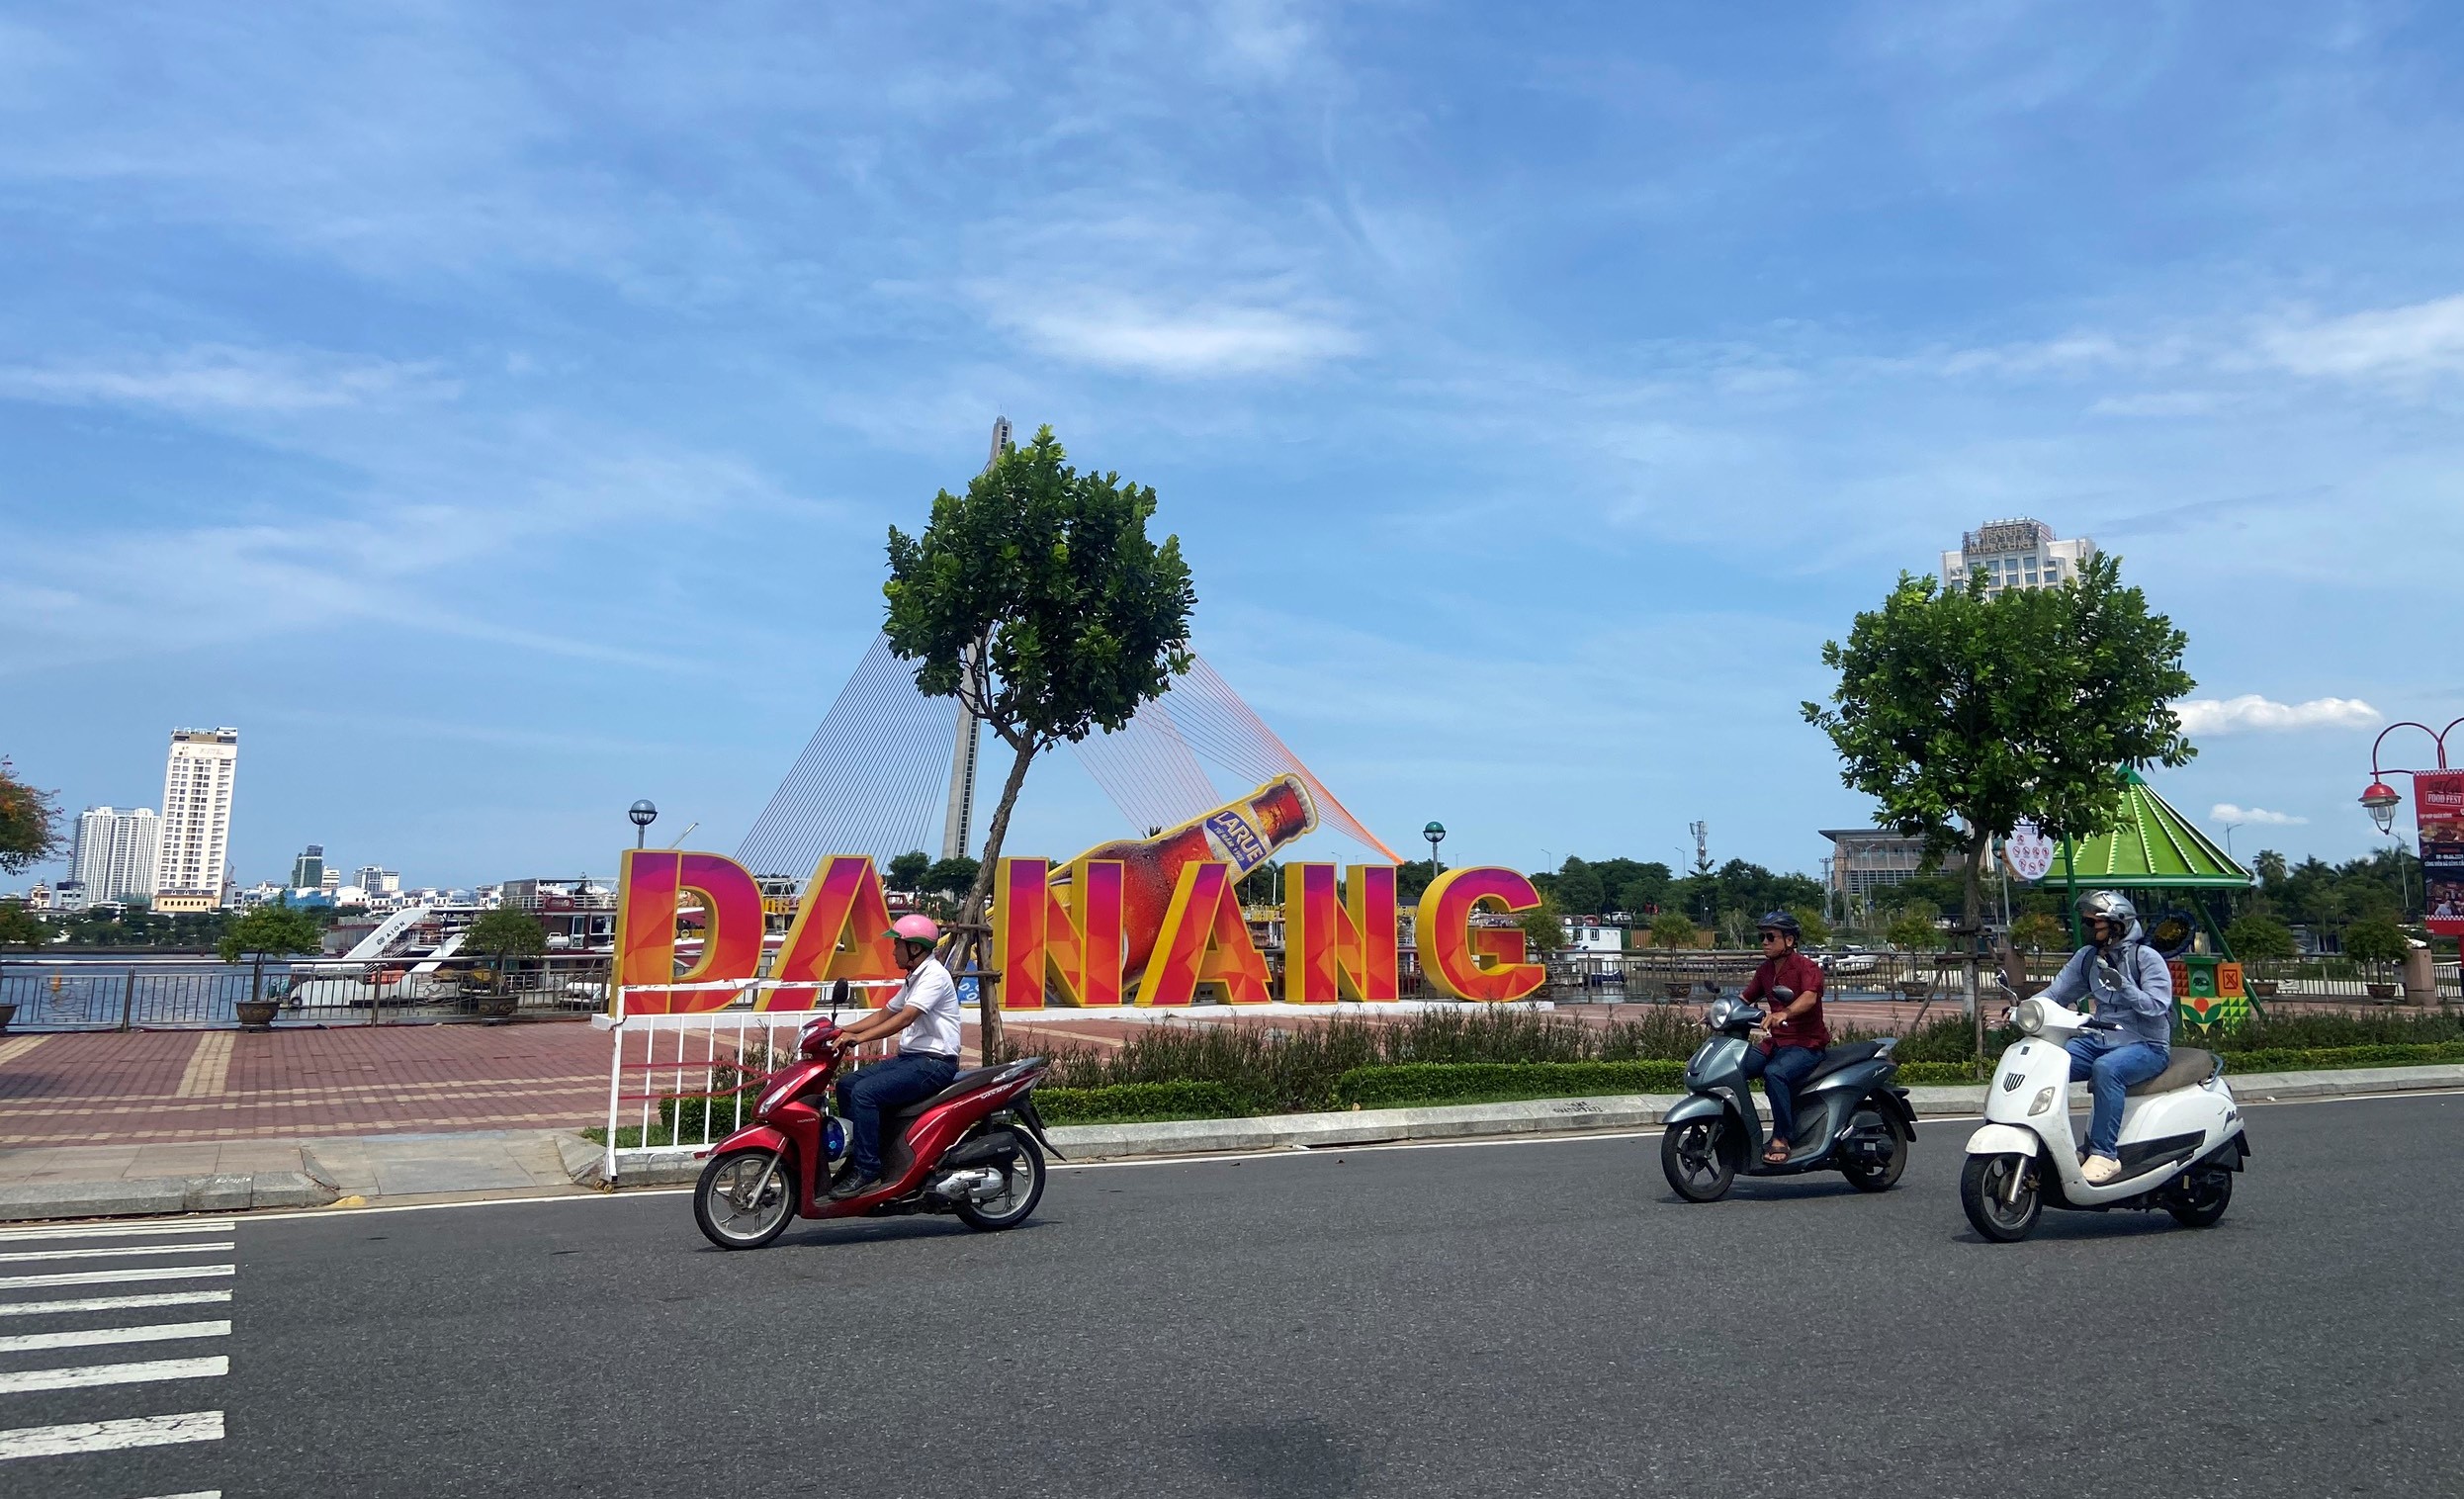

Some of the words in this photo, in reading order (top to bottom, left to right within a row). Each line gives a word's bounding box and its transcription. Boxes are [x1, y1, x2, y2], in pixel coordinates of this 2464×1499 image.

[1969, 539, 2034, 554] MERCURE
[2427, 793, 2445, 803] FOOD
[2446, 795, 2462, 804] FEST
[1213, 812, 1264, 862] LARUE
[387, 921, 405, 938] AION
